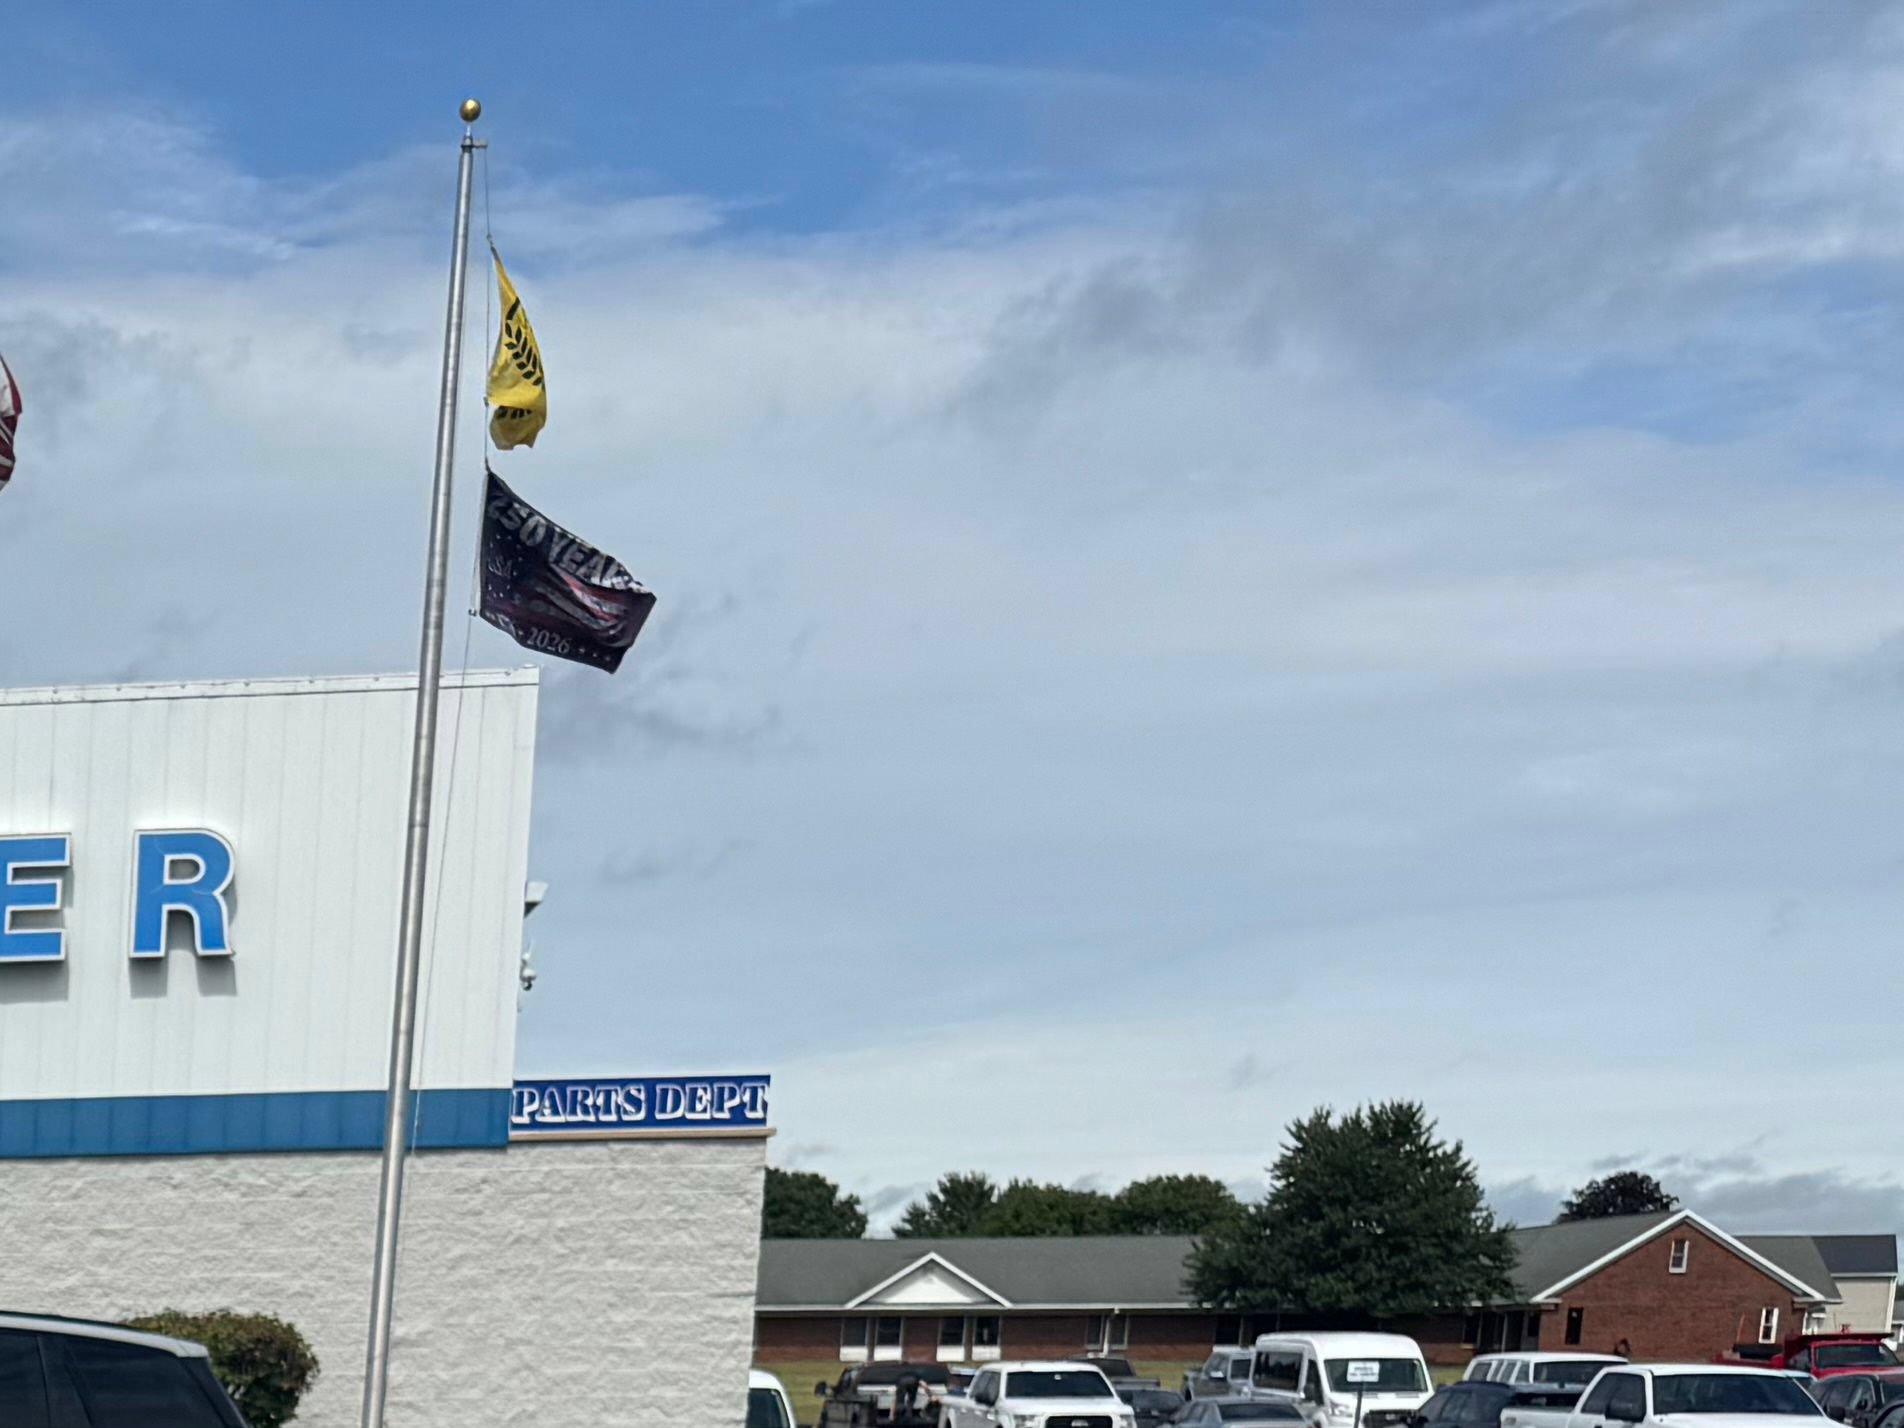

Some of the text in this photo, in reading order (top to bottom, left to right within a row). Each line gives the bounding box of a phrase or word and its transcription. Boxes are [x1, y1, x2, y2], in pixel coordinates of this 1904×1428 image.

[527, 627, 571, 653] 2026
[510, 1083, 769, 1124] PARTS DEPT
